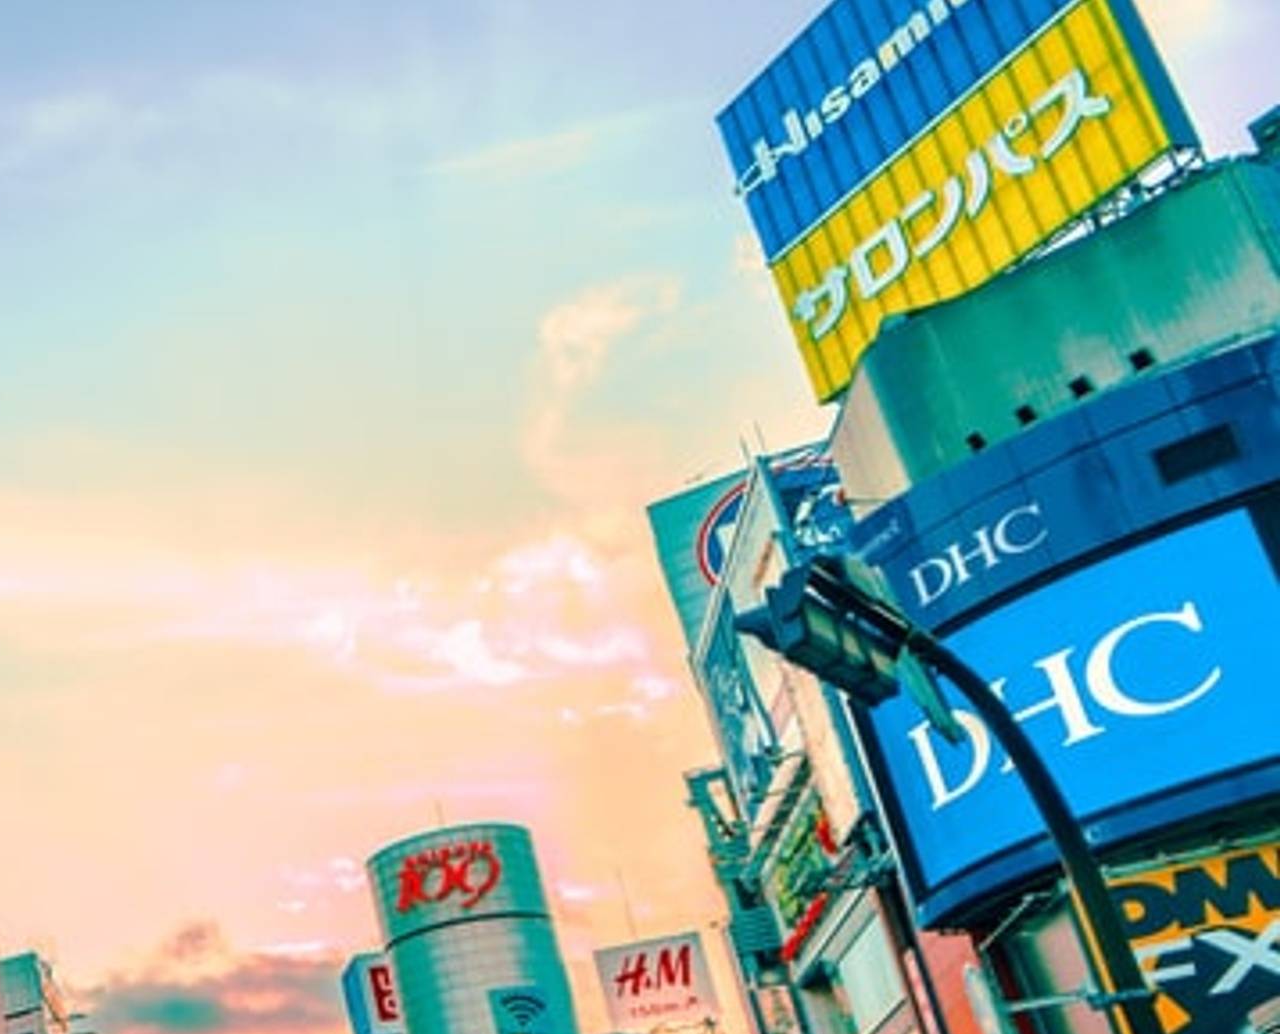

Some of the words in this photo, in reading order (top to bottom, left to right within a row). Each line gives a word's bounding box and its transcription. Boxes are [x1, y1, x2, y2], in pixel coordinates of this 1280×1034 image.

[734, 0, 970, 193] Hisami
[793, 67, 1110, 339] サロンパス
[910, 504, 1048, 605] DHC
[907, 601, 1221, 812] DHC
[396, 849, 502, 913] 109
[614, 945, 692, 998] H&M
